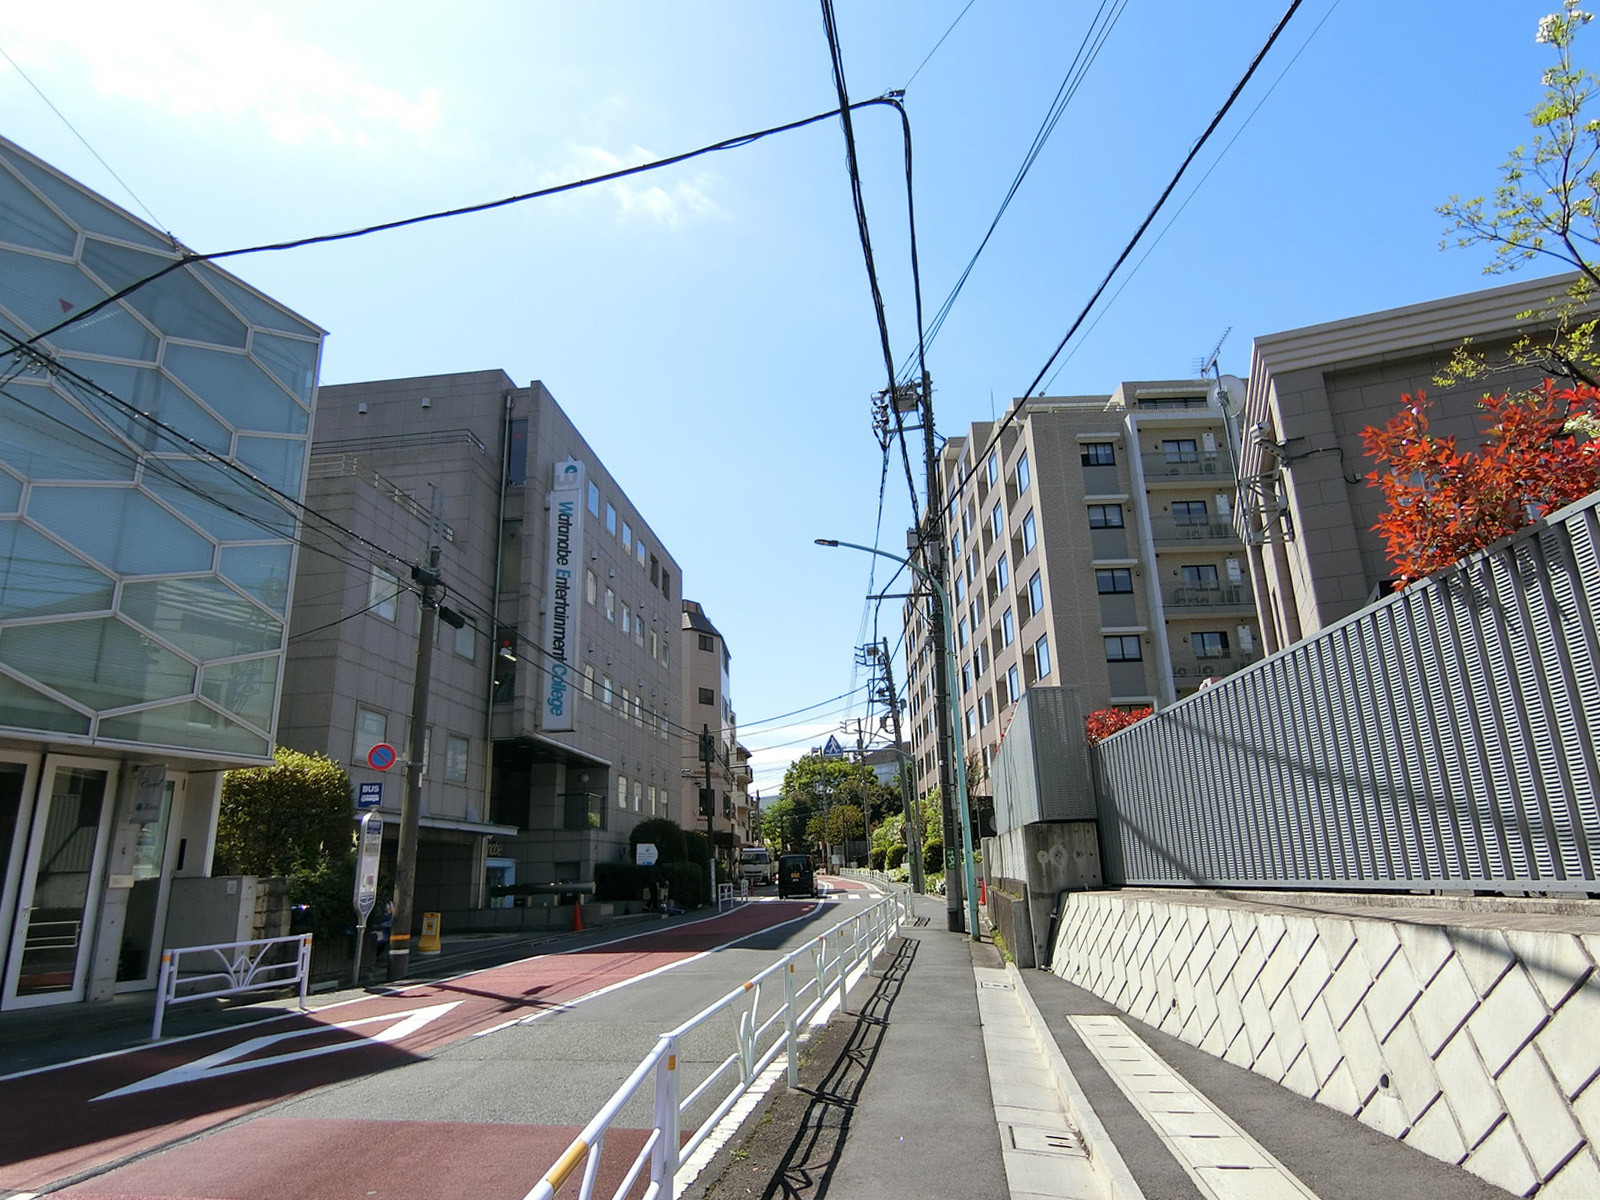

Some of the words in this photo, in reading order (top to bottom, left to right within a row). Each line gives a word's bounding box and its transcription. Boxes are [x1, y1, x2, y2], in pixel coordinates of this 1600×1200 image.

[556, 501, 574, 566] Watanabe
[553, 568, 571, 662] Entertainment
[546, 663, 567, 717] College
[362, 784, 380, 793] BUS
